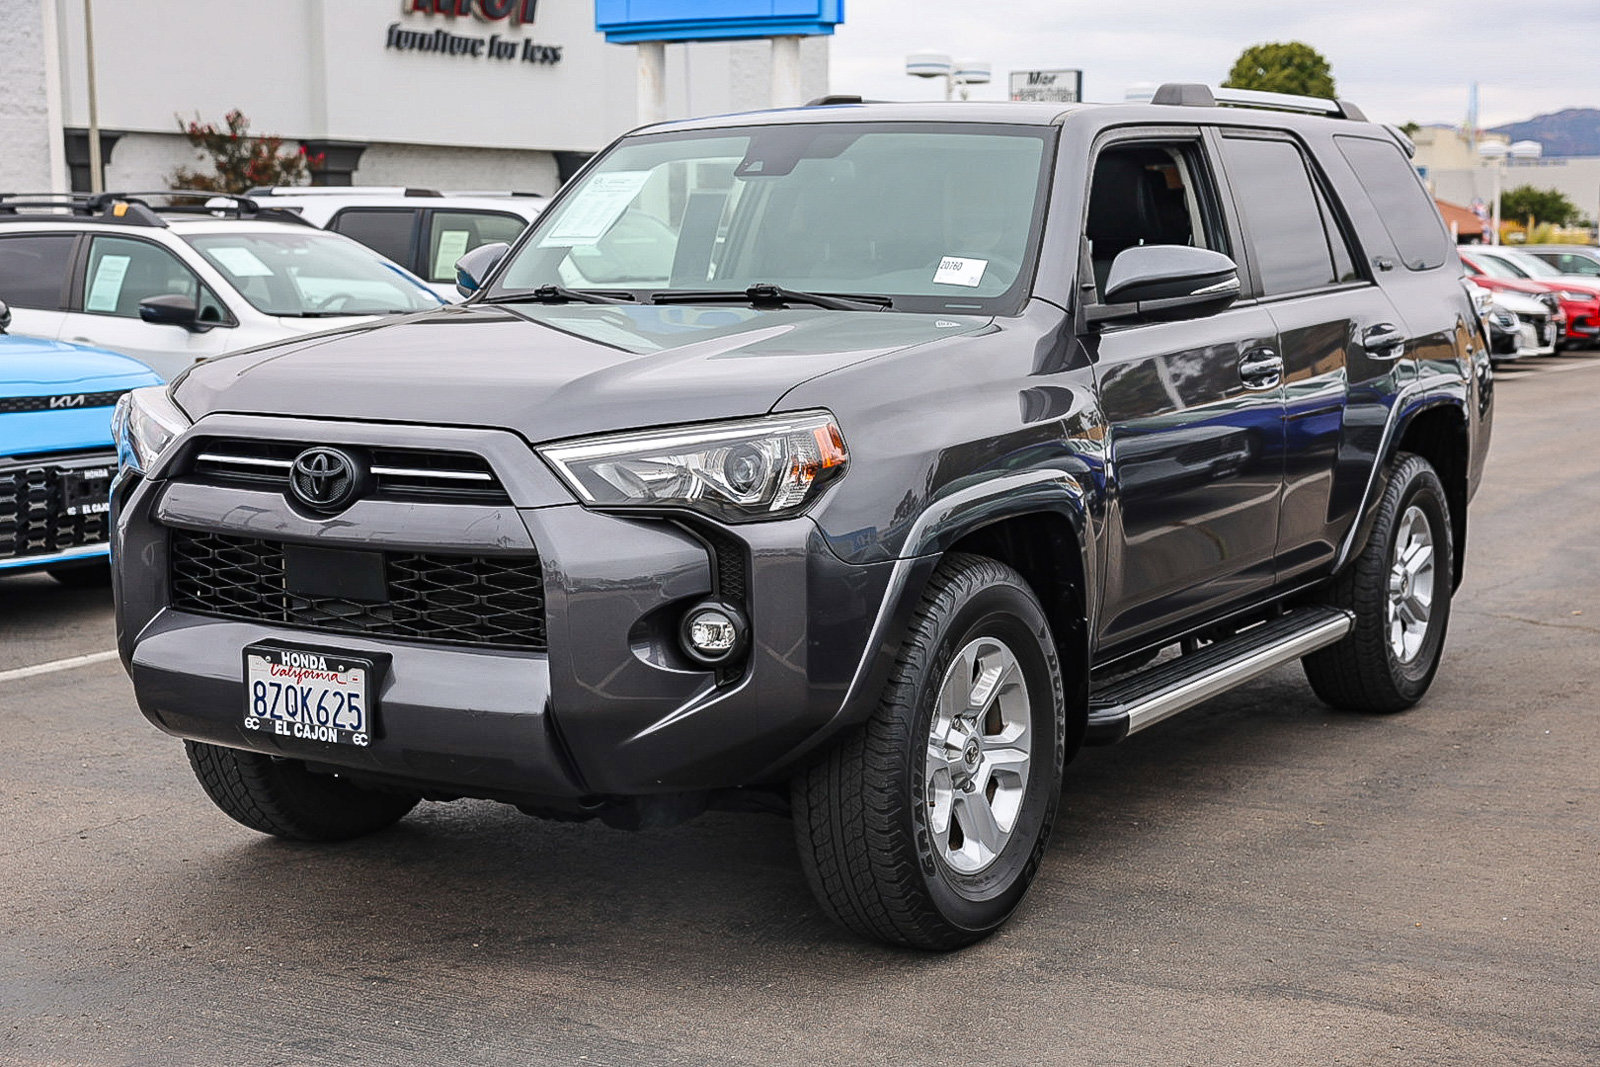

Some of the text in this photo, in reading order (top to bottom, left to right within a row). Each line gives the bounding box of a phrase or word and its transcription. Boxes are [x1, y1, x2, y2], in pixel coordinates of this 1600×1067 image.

[387, 23, 563, 65] furniture for less
[281, 651, 328, 671] HONDA
[270, 663, 347, 685] California
[253, 680, 363, 731] 8ZQK625
[275, 720, 338, 744] EL CAJON
